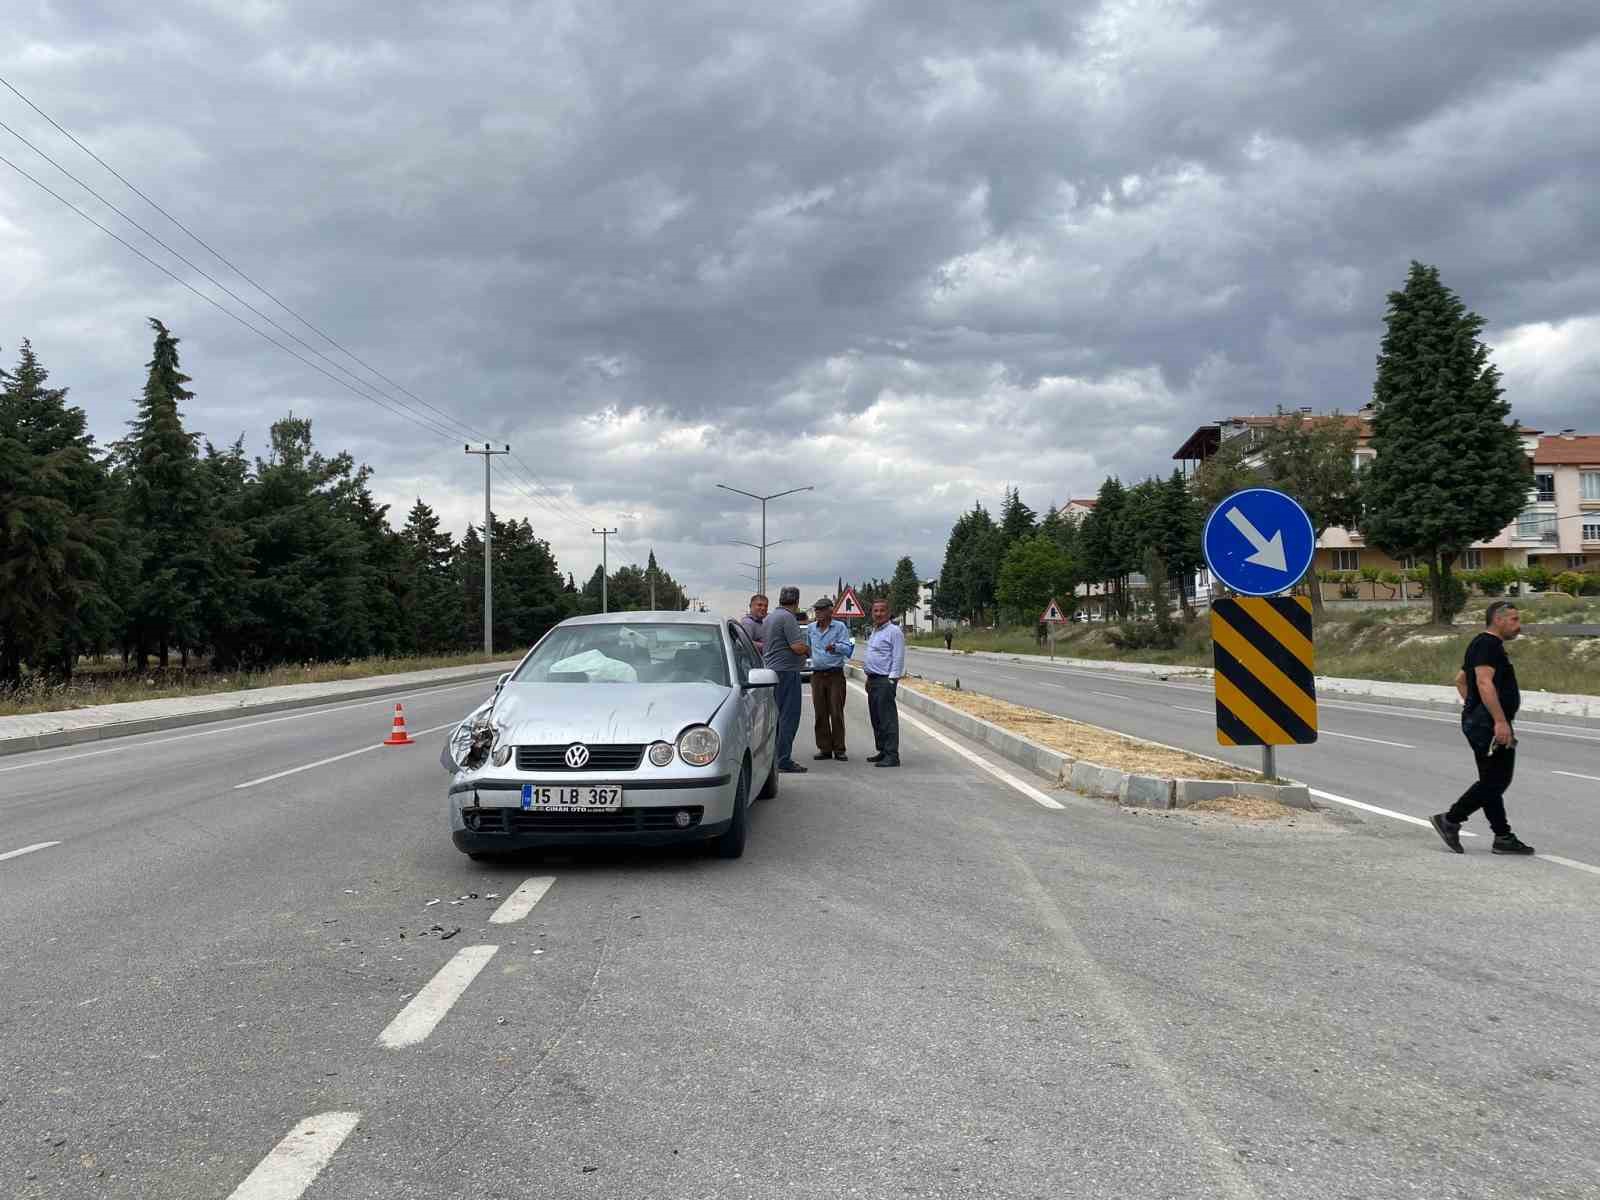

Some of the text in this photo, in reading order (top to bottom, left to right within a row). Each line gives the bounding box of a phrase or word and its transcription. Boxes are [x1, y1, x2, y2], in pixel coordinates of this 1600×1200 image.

[565, 745, 590, 768] VW
[534, 788, 618, 805] 15 LB 367
